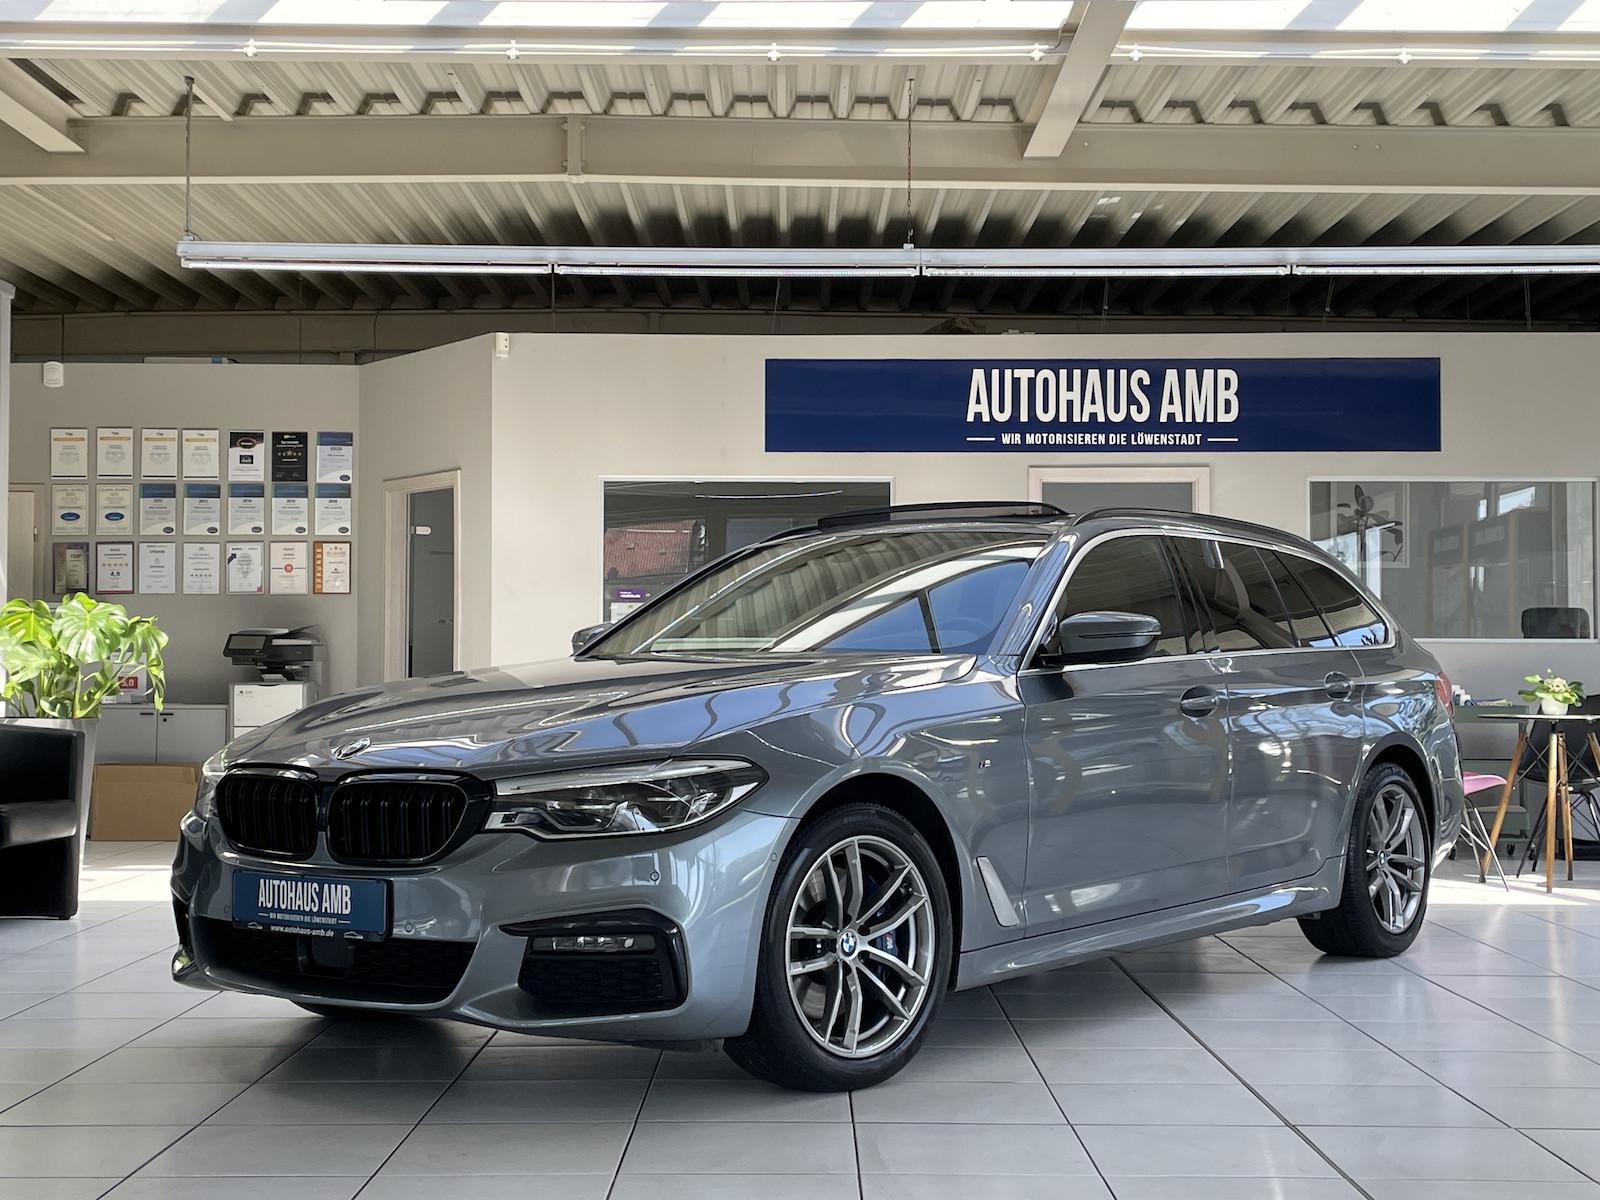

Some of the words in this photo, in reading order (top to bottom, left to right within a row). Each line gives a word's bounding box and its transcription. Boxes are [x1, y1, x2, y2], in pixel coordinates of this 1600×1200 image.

[966, 368, 1151, 423] AUTOHAUS
[1159, 368, 1240, 423] AMB
[1001, 433, 1021, 445] WIR
[1025, 433, 1106, 445] MOTORISIEREN
[1109, 433, 1127, 445] DIE
[1131, 431, 1202, 446] LÖWENSTADT
[258, 878, 319, 912] AUTOHAUS
[322, 883, 352, 915] AMB
[271, 925, 334, 937] www.autohaus-amb.de
